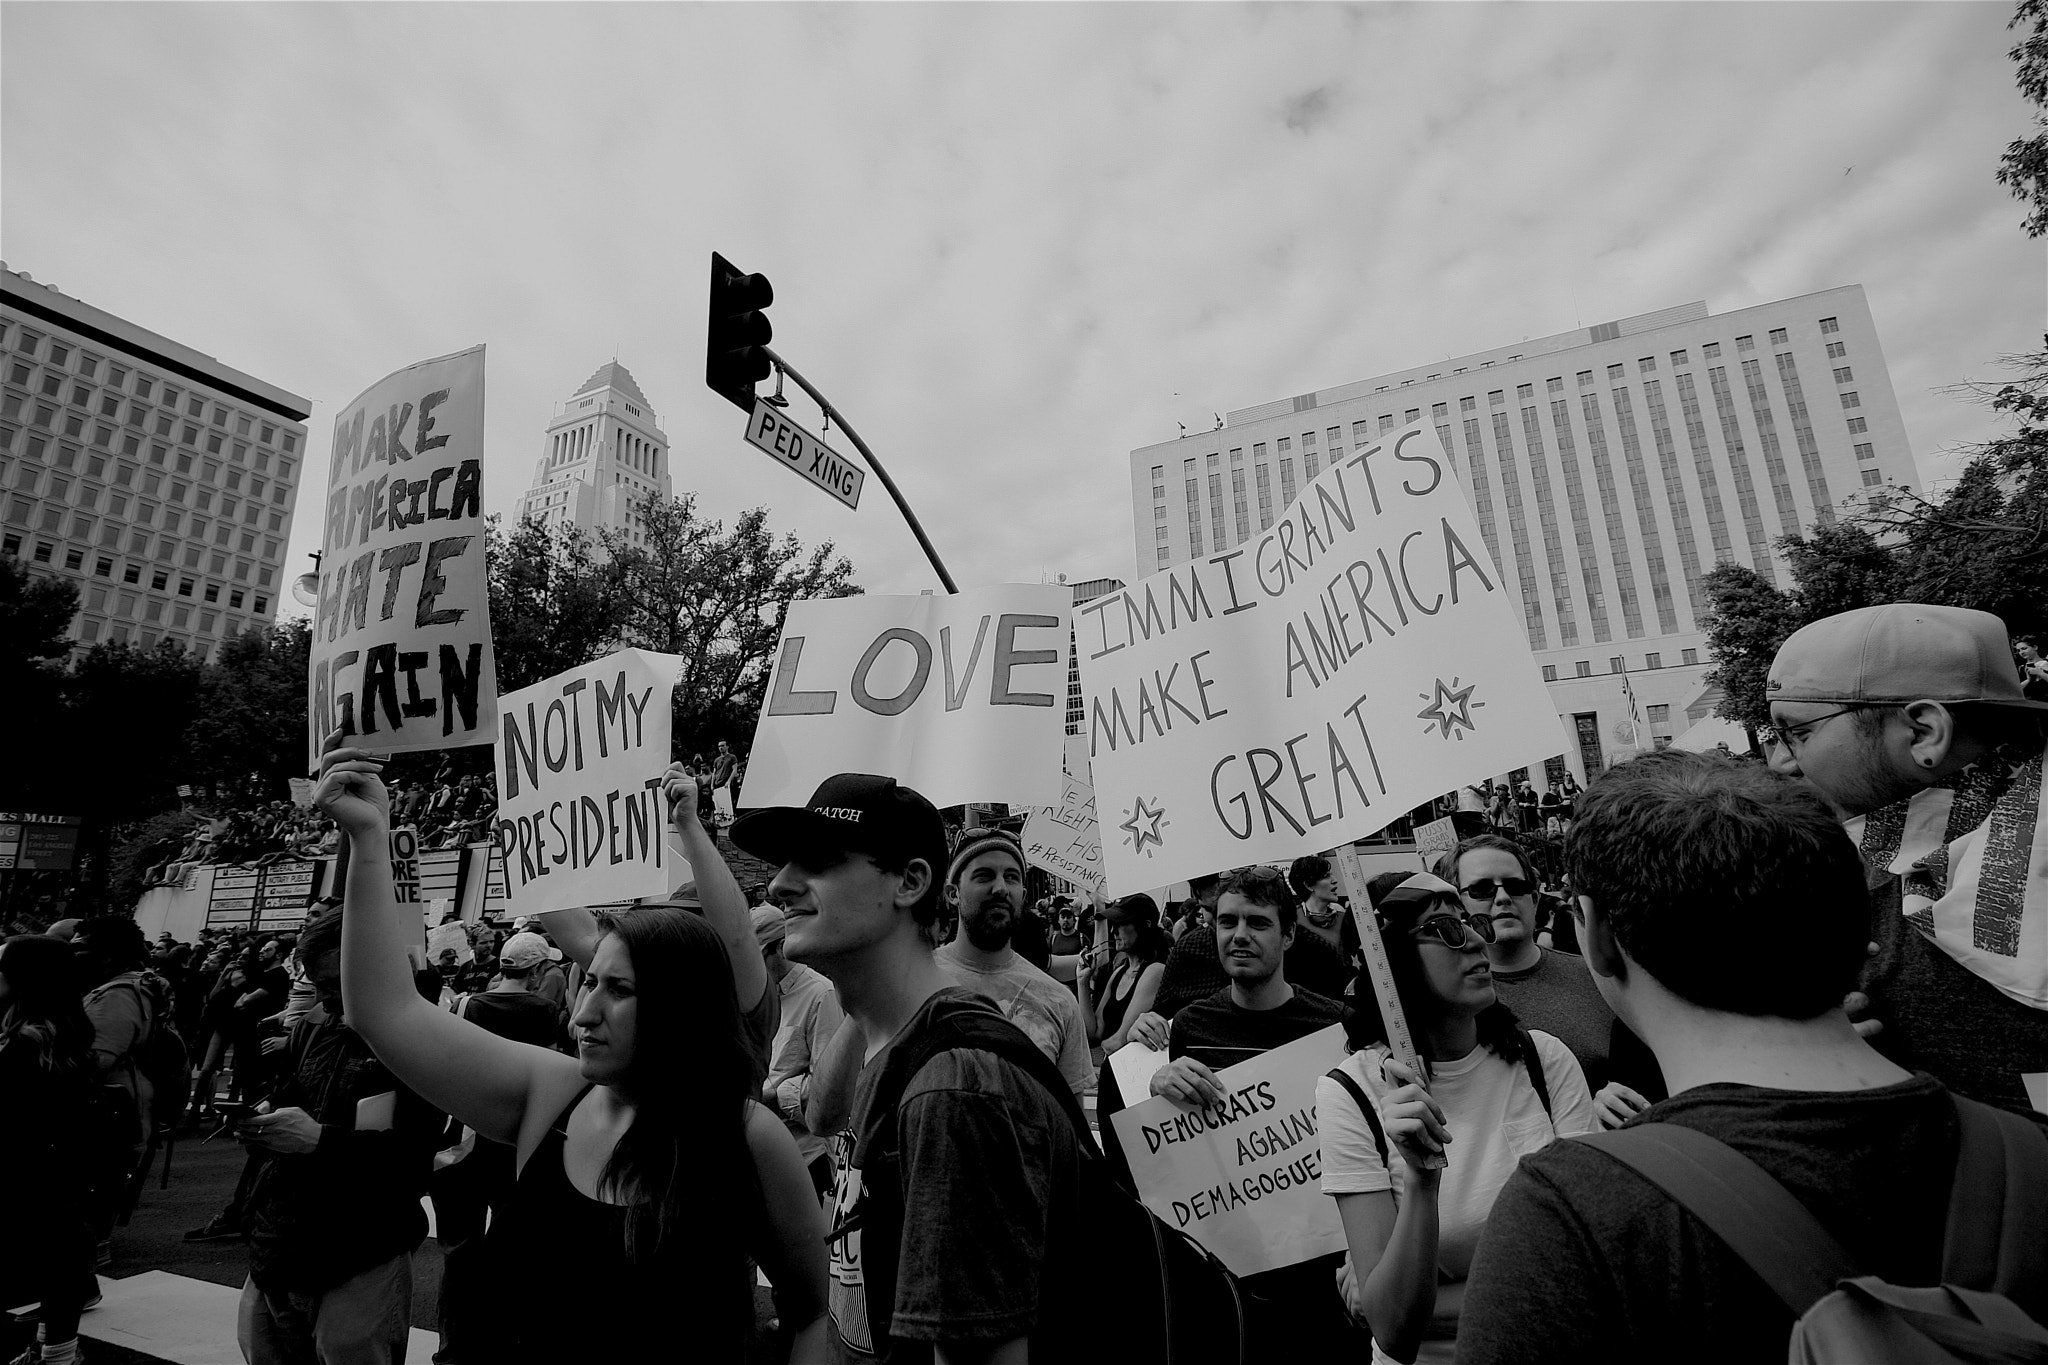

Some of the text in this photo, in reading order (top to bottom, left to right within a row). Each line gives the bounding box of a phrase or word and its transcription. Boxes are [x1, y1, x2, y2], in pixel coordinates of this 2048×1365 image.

[331, 387, 452, 488] MAKE
[758, 411, 854, 496] PED XING
[324, 459, 481, 558] AMERICA
[1080, 429, 1443, 660] IMMIGRANTS
[317, 536, 475, 642] HATE
[1090, 517, 1494, 758] MAKE AMERICA
[314, 643, 483, 759] AGAIN
[767, 613, 1060, 717] LOVE
[503, 670, 653, 800] NOT MY
[1211, 694, 1387, 840] GREAT
[23, 813, 67, 825] MALL
[500, 777, 663, 899] PRESIDENT
[1066, 836, 1103, 864] HIS
[1081, 795, 1098, 818] A
[1418, 820, 1448, 839] PUSSY
[1423, 832, 1449, 846] GRABS
[1372, 942, 1379, 951] 29
[1377, 962, 1383, 970] 30
[1388, 1000, 1395, 1008] 32
[1394, 1020, 1400, 1028] 33
[1400, 1041, 1407, 1049] 34
[1141, 1081, 1276, 1154] DEMOCRATS
